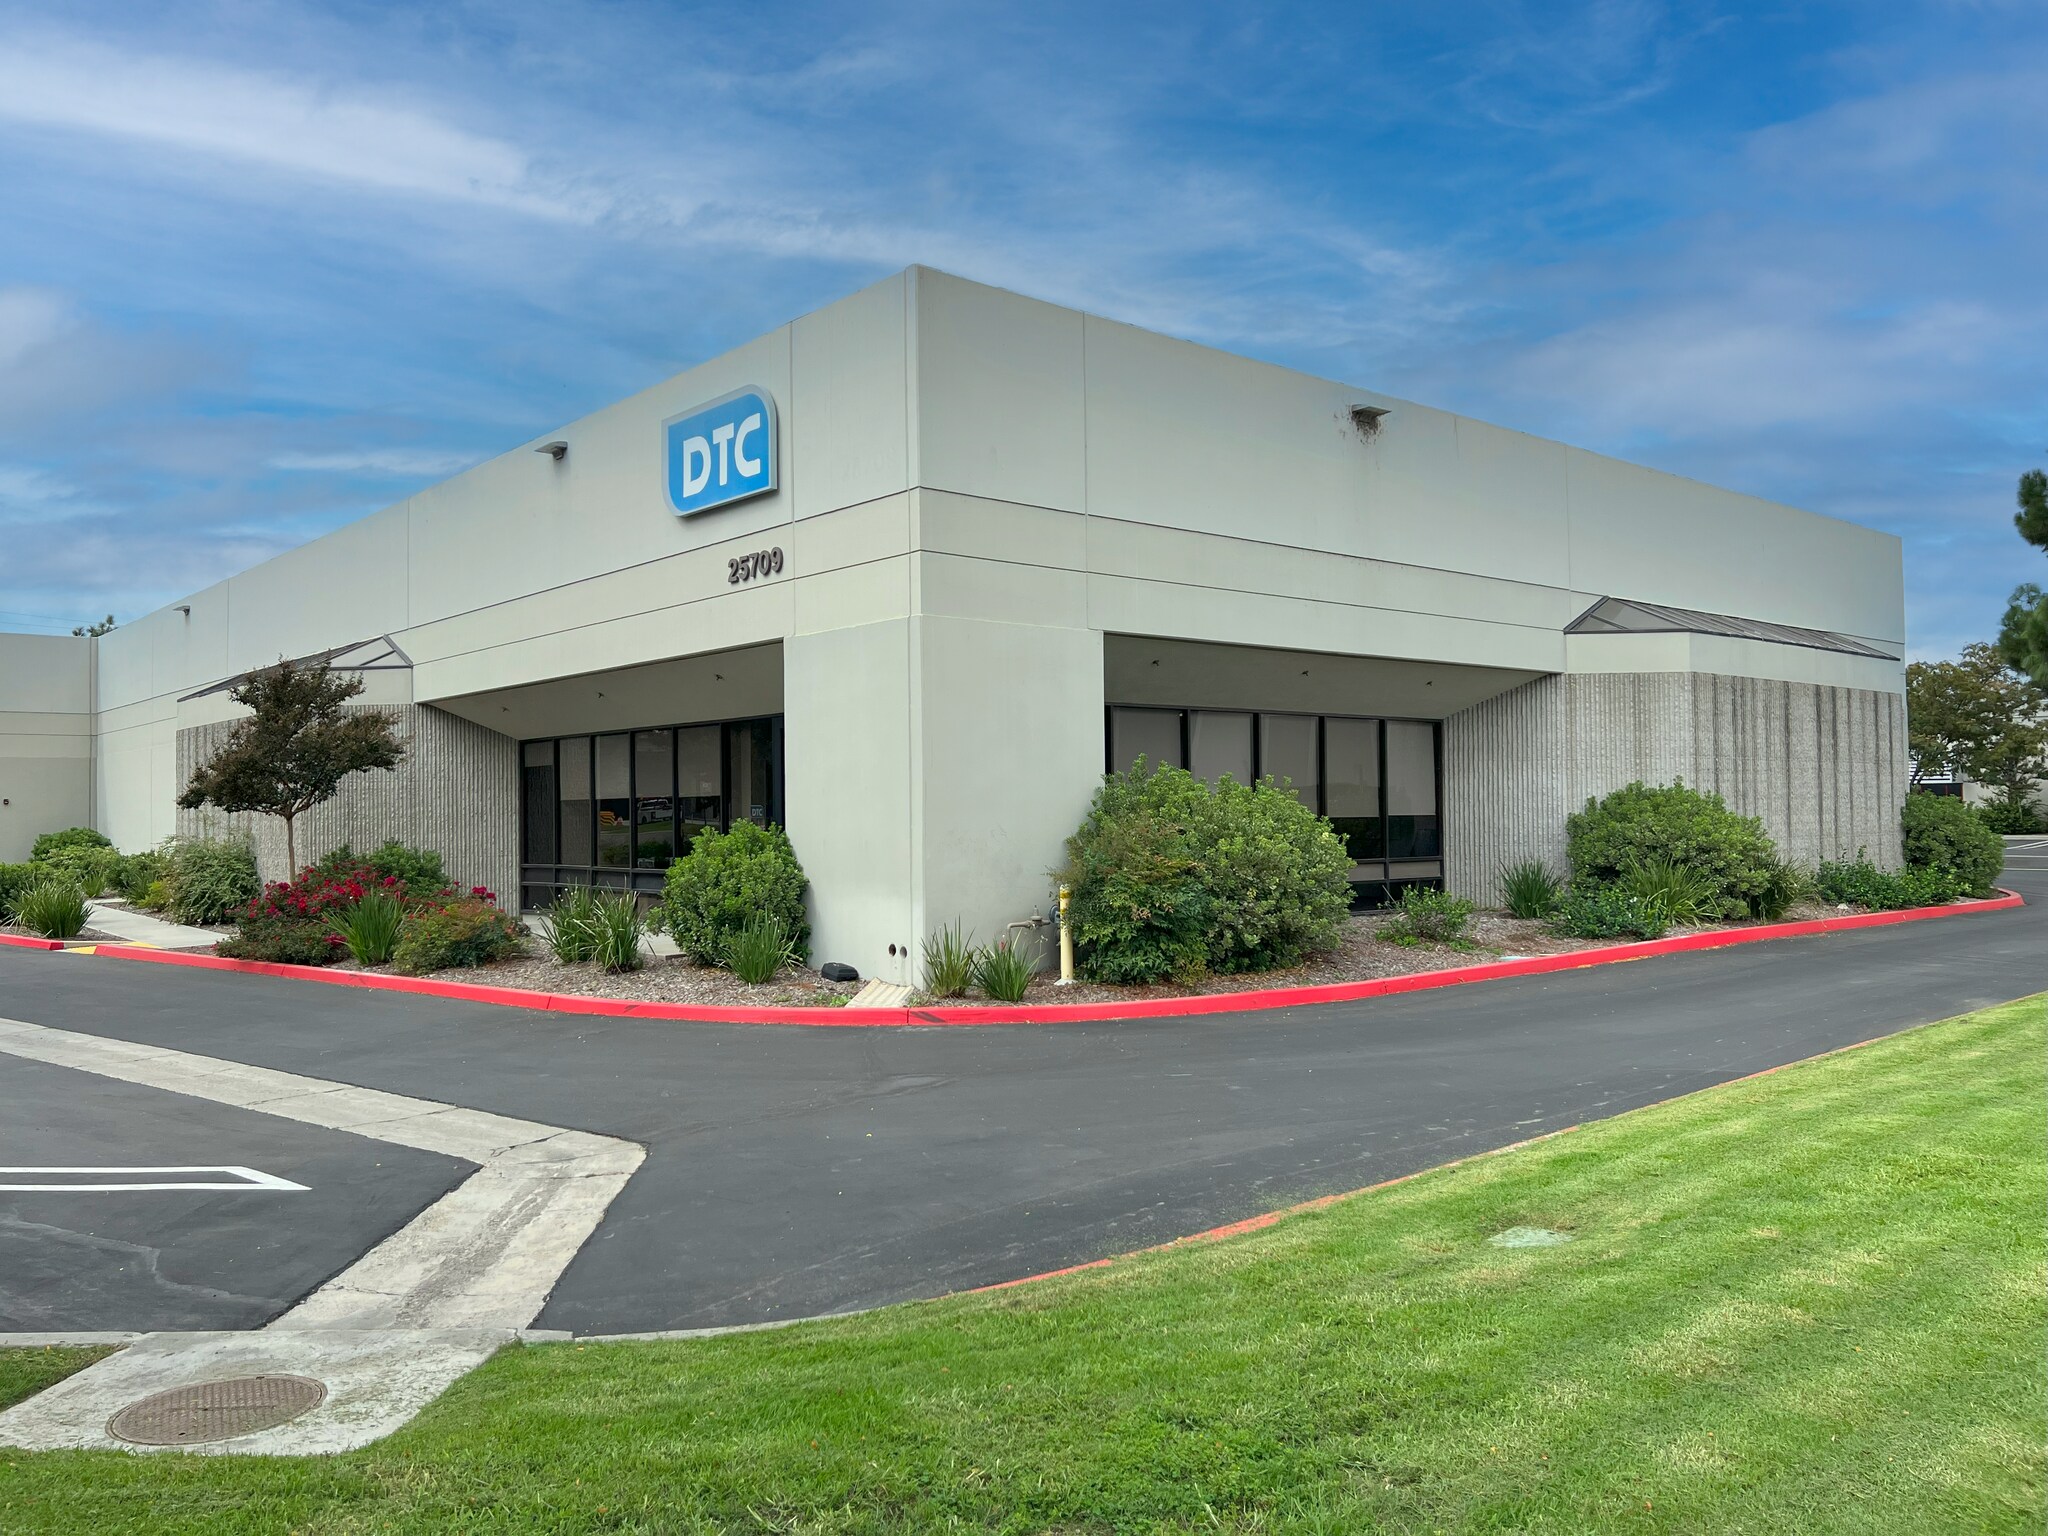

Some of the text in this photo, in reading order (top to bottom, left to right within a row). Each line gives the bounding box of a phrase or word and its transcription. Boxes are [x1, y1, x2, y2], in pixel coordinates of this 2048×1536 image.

[683, 412, 761, 498] DTC
[728, 546, 784, 584] 25709
[751, 808, 763, 817] DTC
